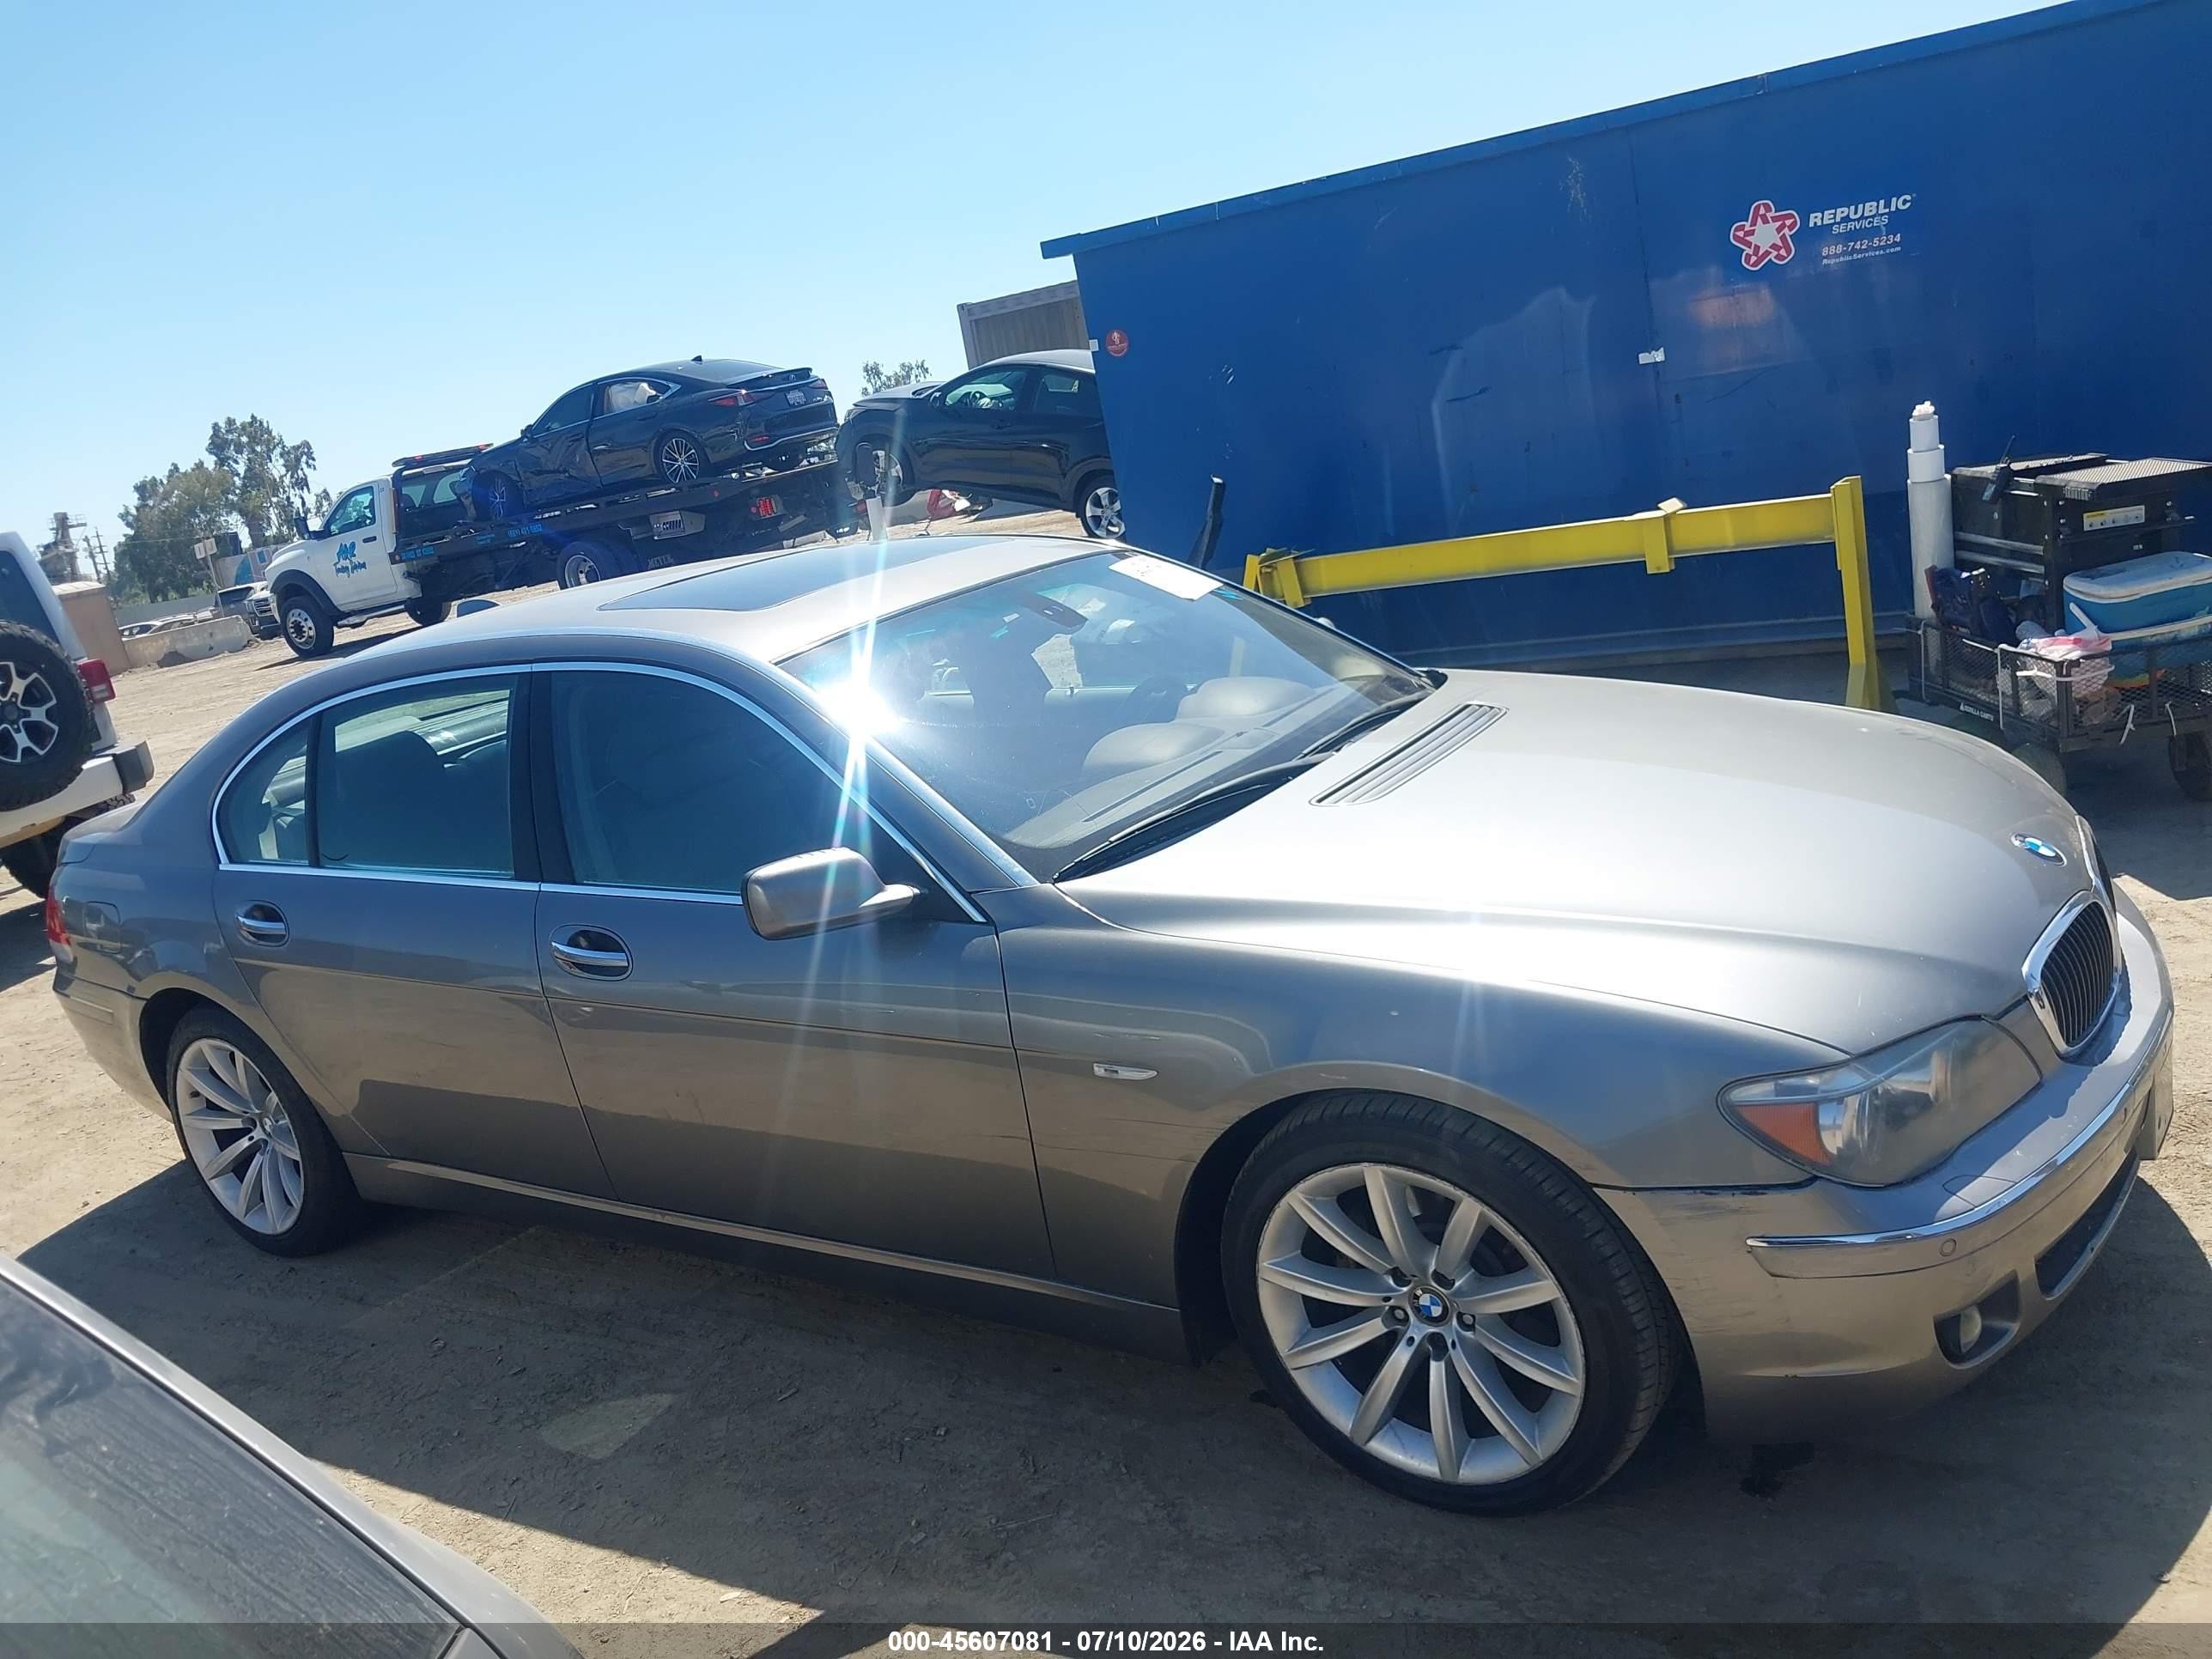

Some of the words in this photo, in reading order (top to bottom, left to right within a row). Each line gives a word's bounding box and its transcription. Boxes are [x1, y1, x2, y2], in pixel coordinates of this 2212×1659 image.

[1808, 194, 1912, 228] REPUBLIC
[1832, 215, 1889, 234] SERVICES
[1821, 233, 1901, 257] 888-742-5234
[1821, 246, 1902, 265] RepublicServices.com
